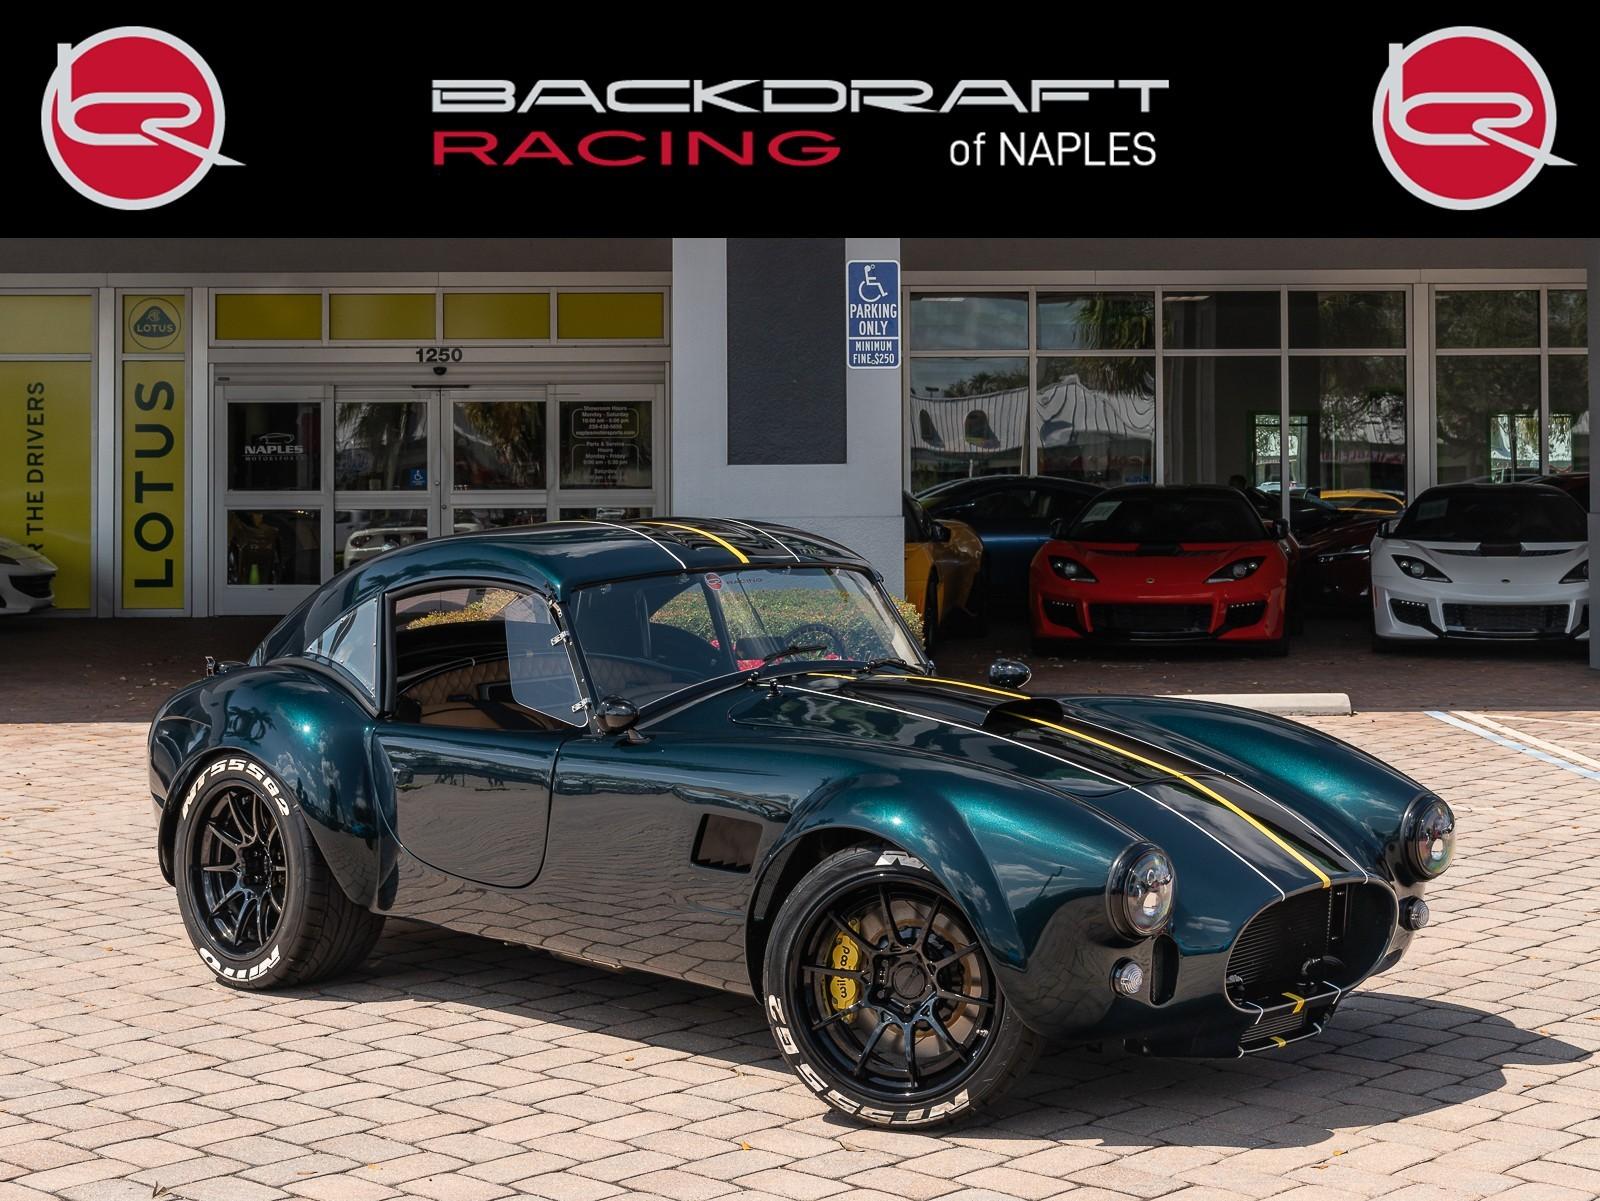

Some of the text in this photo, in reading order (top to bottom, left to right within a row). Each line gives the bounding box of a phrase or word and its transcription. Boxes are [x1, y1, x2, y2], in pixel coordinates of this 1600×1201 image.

[849, 303, 897, 319] PARKING
[136, 323, 174, 333] LOTUS
[858, 320, 889, 336] ONLY
[855, 340, 892, 352] MINIMUM
[415, 347, 463, 363] 1250
[852, 352, 895, 365] FINE $250
[26, 381, 45, 484] DRIVERS
[244, 445, 305, 455] NAPLES
[134, 380, 175, 588] LOTUS
[26, 490, 45, 536] THE
[836, 945, 851, 998] wilood
